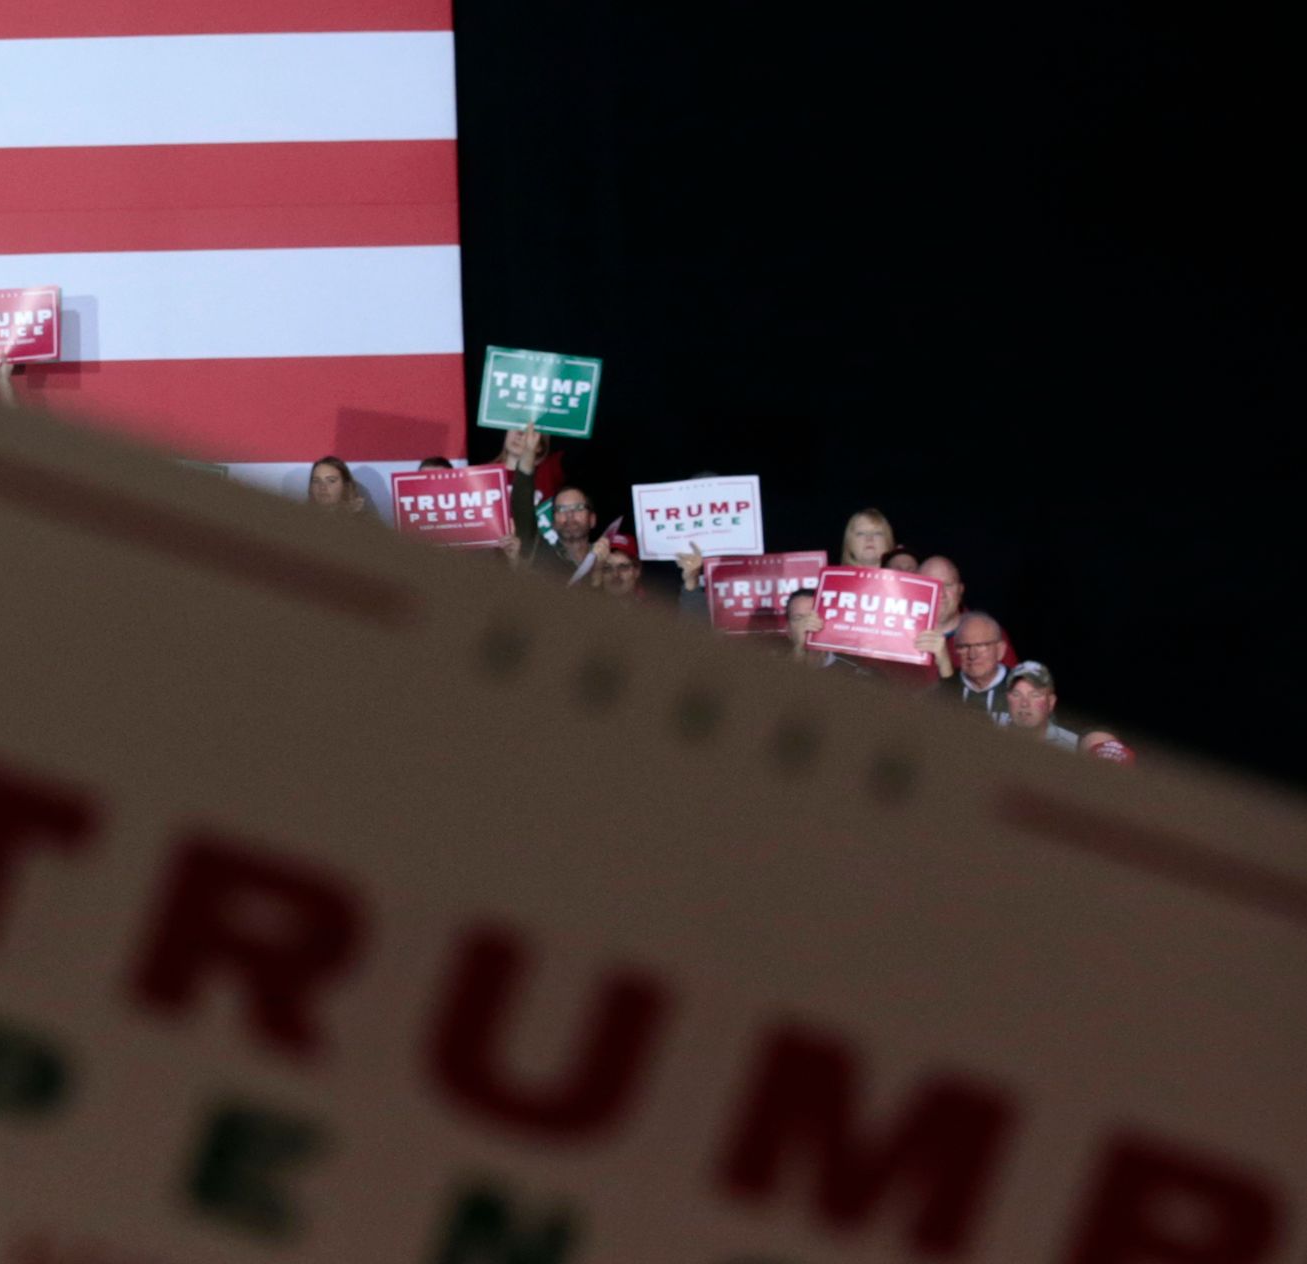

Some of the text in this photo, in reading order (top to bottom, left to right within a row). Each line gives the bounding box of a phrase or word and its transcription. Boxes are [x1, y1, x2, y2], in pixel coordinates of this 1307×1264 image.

[492, 371, 592, 397] TRUMP
[497, 388, 581, 409] PENCE
[399, 488, 502, 512] TRUMP
[409, 508, 494, 524] PENCE
[645, 501, 751, 522] TRUMP
[655, 517, 741, 533] PENCE
[821, 591, 931, 618] TRUMP
[825, 608, 917, 630] PENCE
